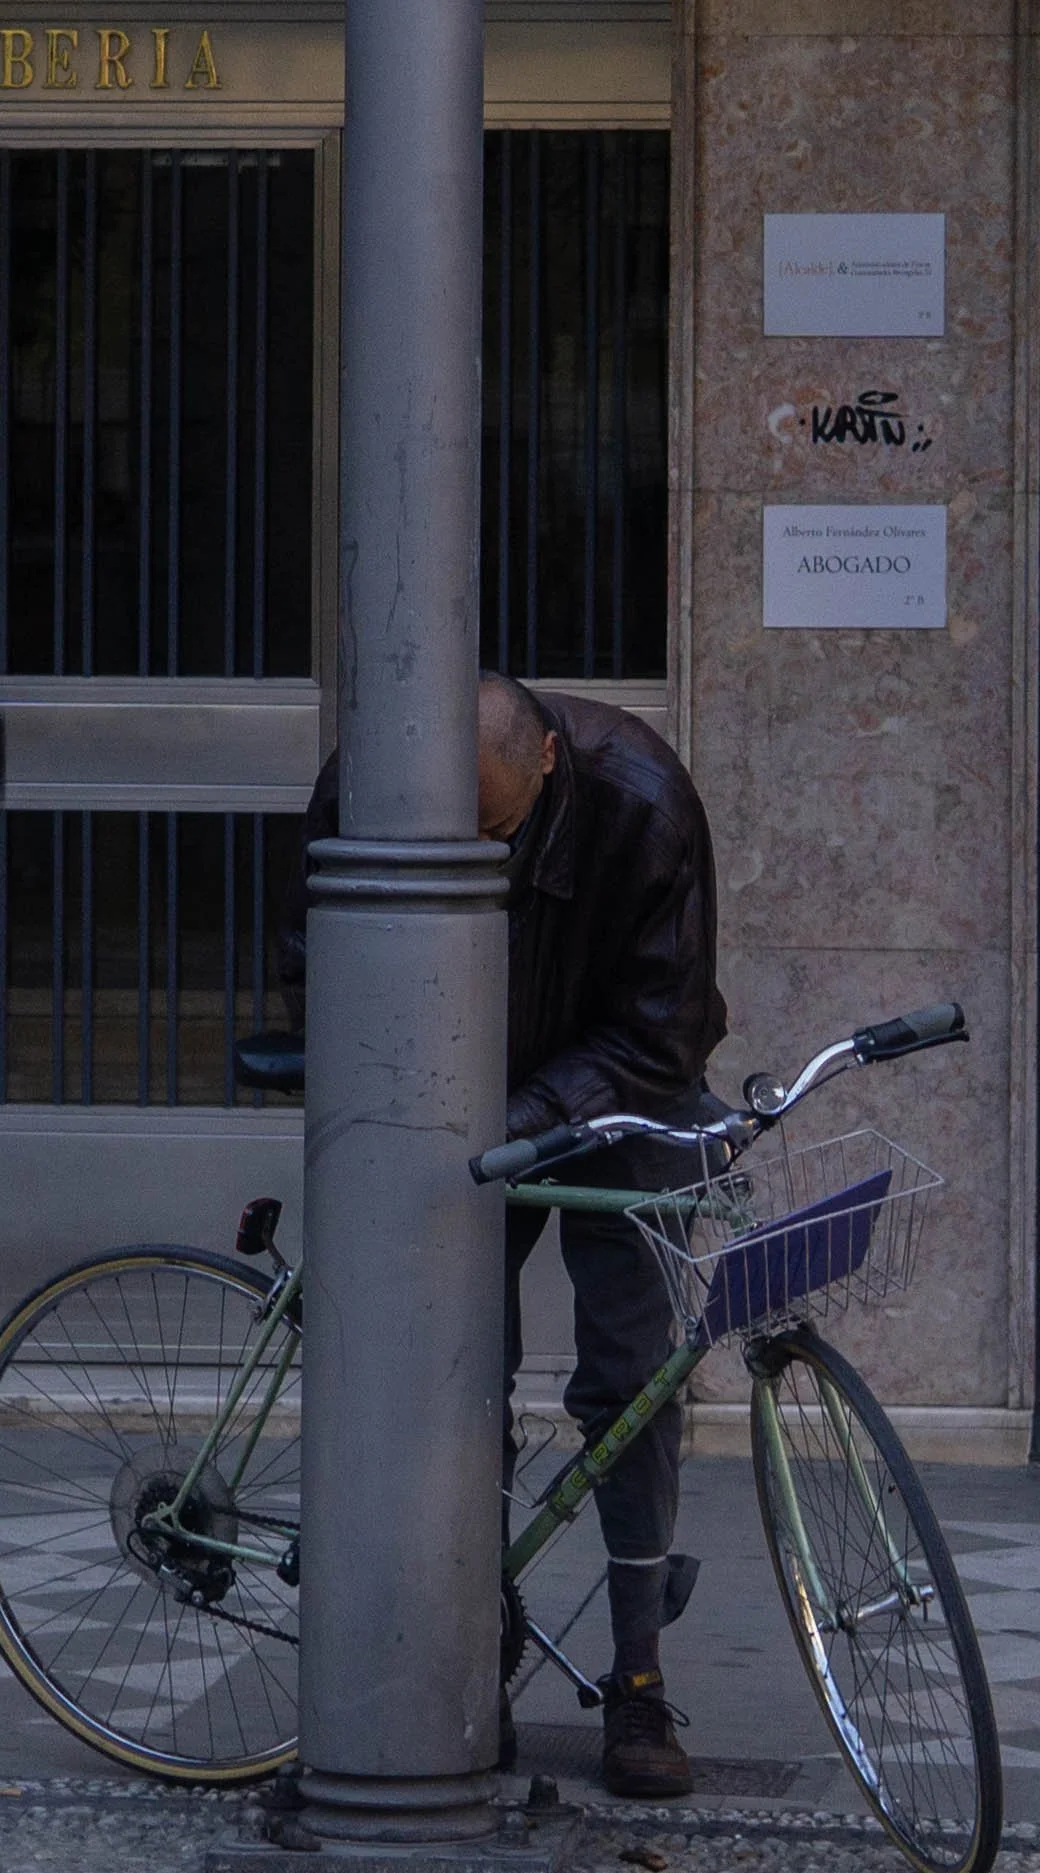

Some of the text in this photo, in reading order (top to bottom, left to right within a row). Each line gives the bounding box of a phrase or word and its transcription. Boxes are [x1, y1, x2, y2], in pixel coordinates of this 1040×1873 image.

[837, 261, 849, 275] &
[783, 524, 927, 538] Alberto Fernández Olivares
[796, 555, 912, 574] ABOGADO
[551, 1367, 671, 1511] TERROT
